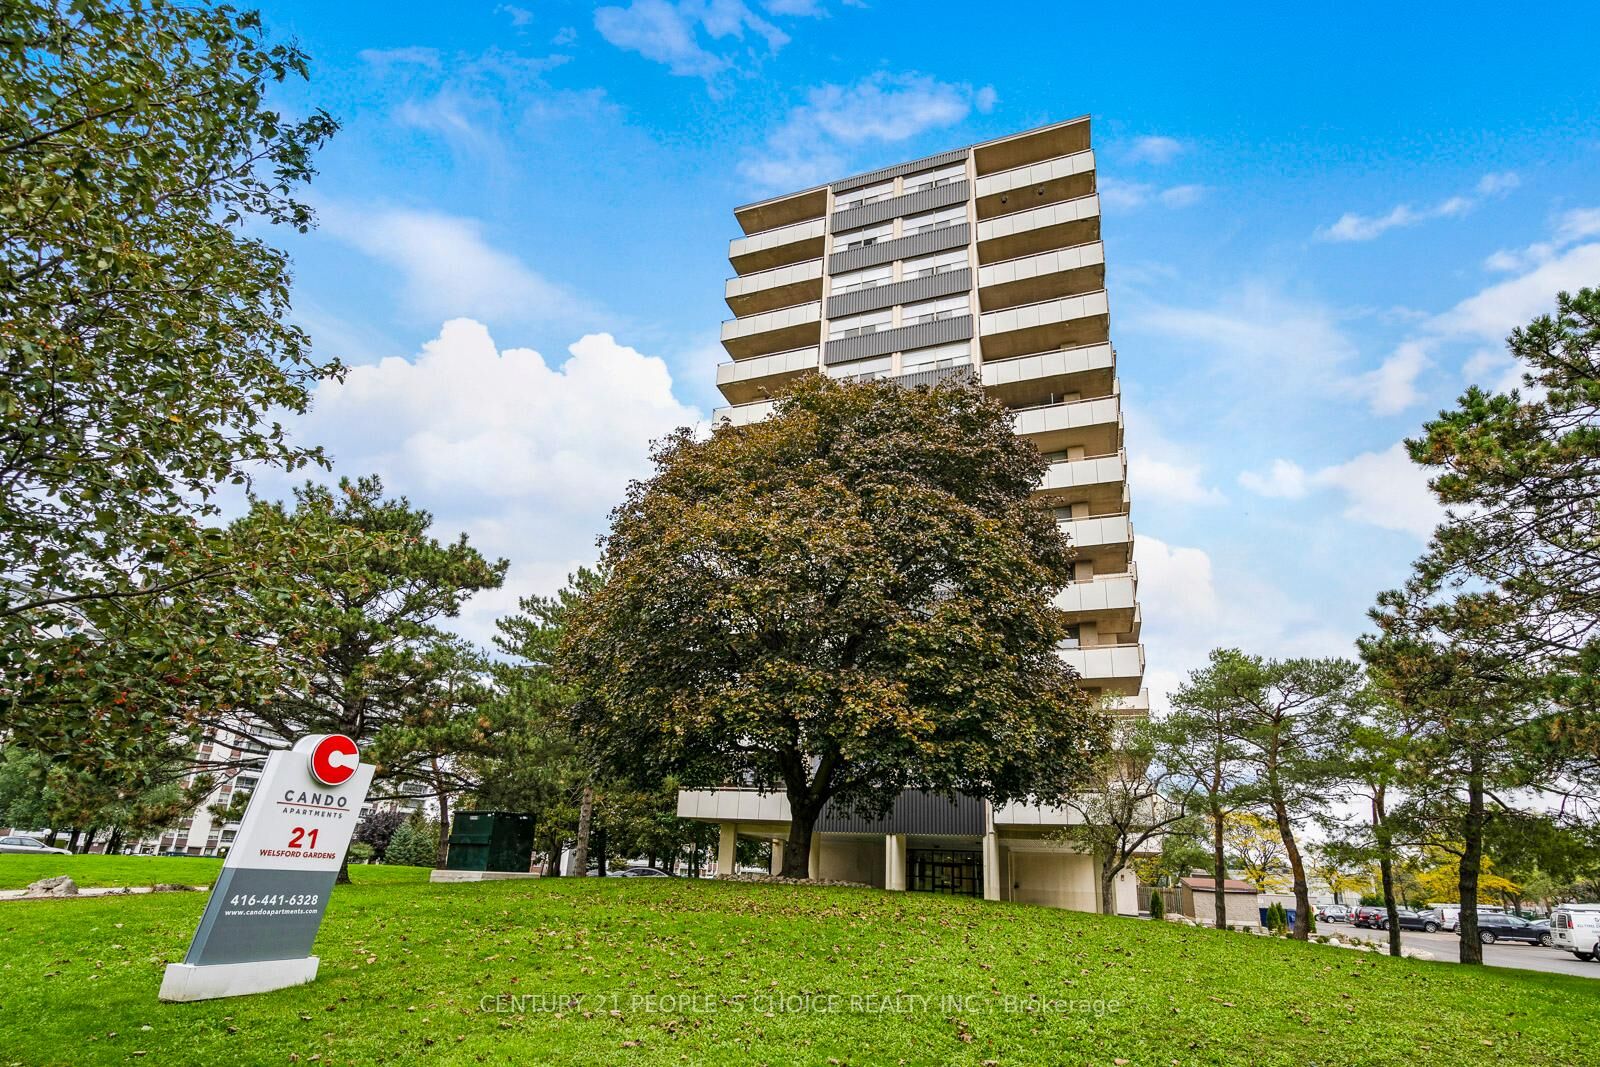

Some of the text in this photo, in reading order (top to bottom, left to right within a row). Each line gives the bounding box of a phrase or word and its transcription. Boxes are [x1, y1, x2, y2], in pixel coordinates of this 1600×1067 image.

[313, 734, 357, 784] C
[284, 790, 347, 807] CANDO
[282, 807, 343, 819] APARTMENTS
[288, 827, 319, 849] 21
[260, 849, 336, 860] WELSFORD GARDENS
[230, 895, 319, 906] 416-441-6328
[224, 908, 318, 917] www.candoapartments.com
